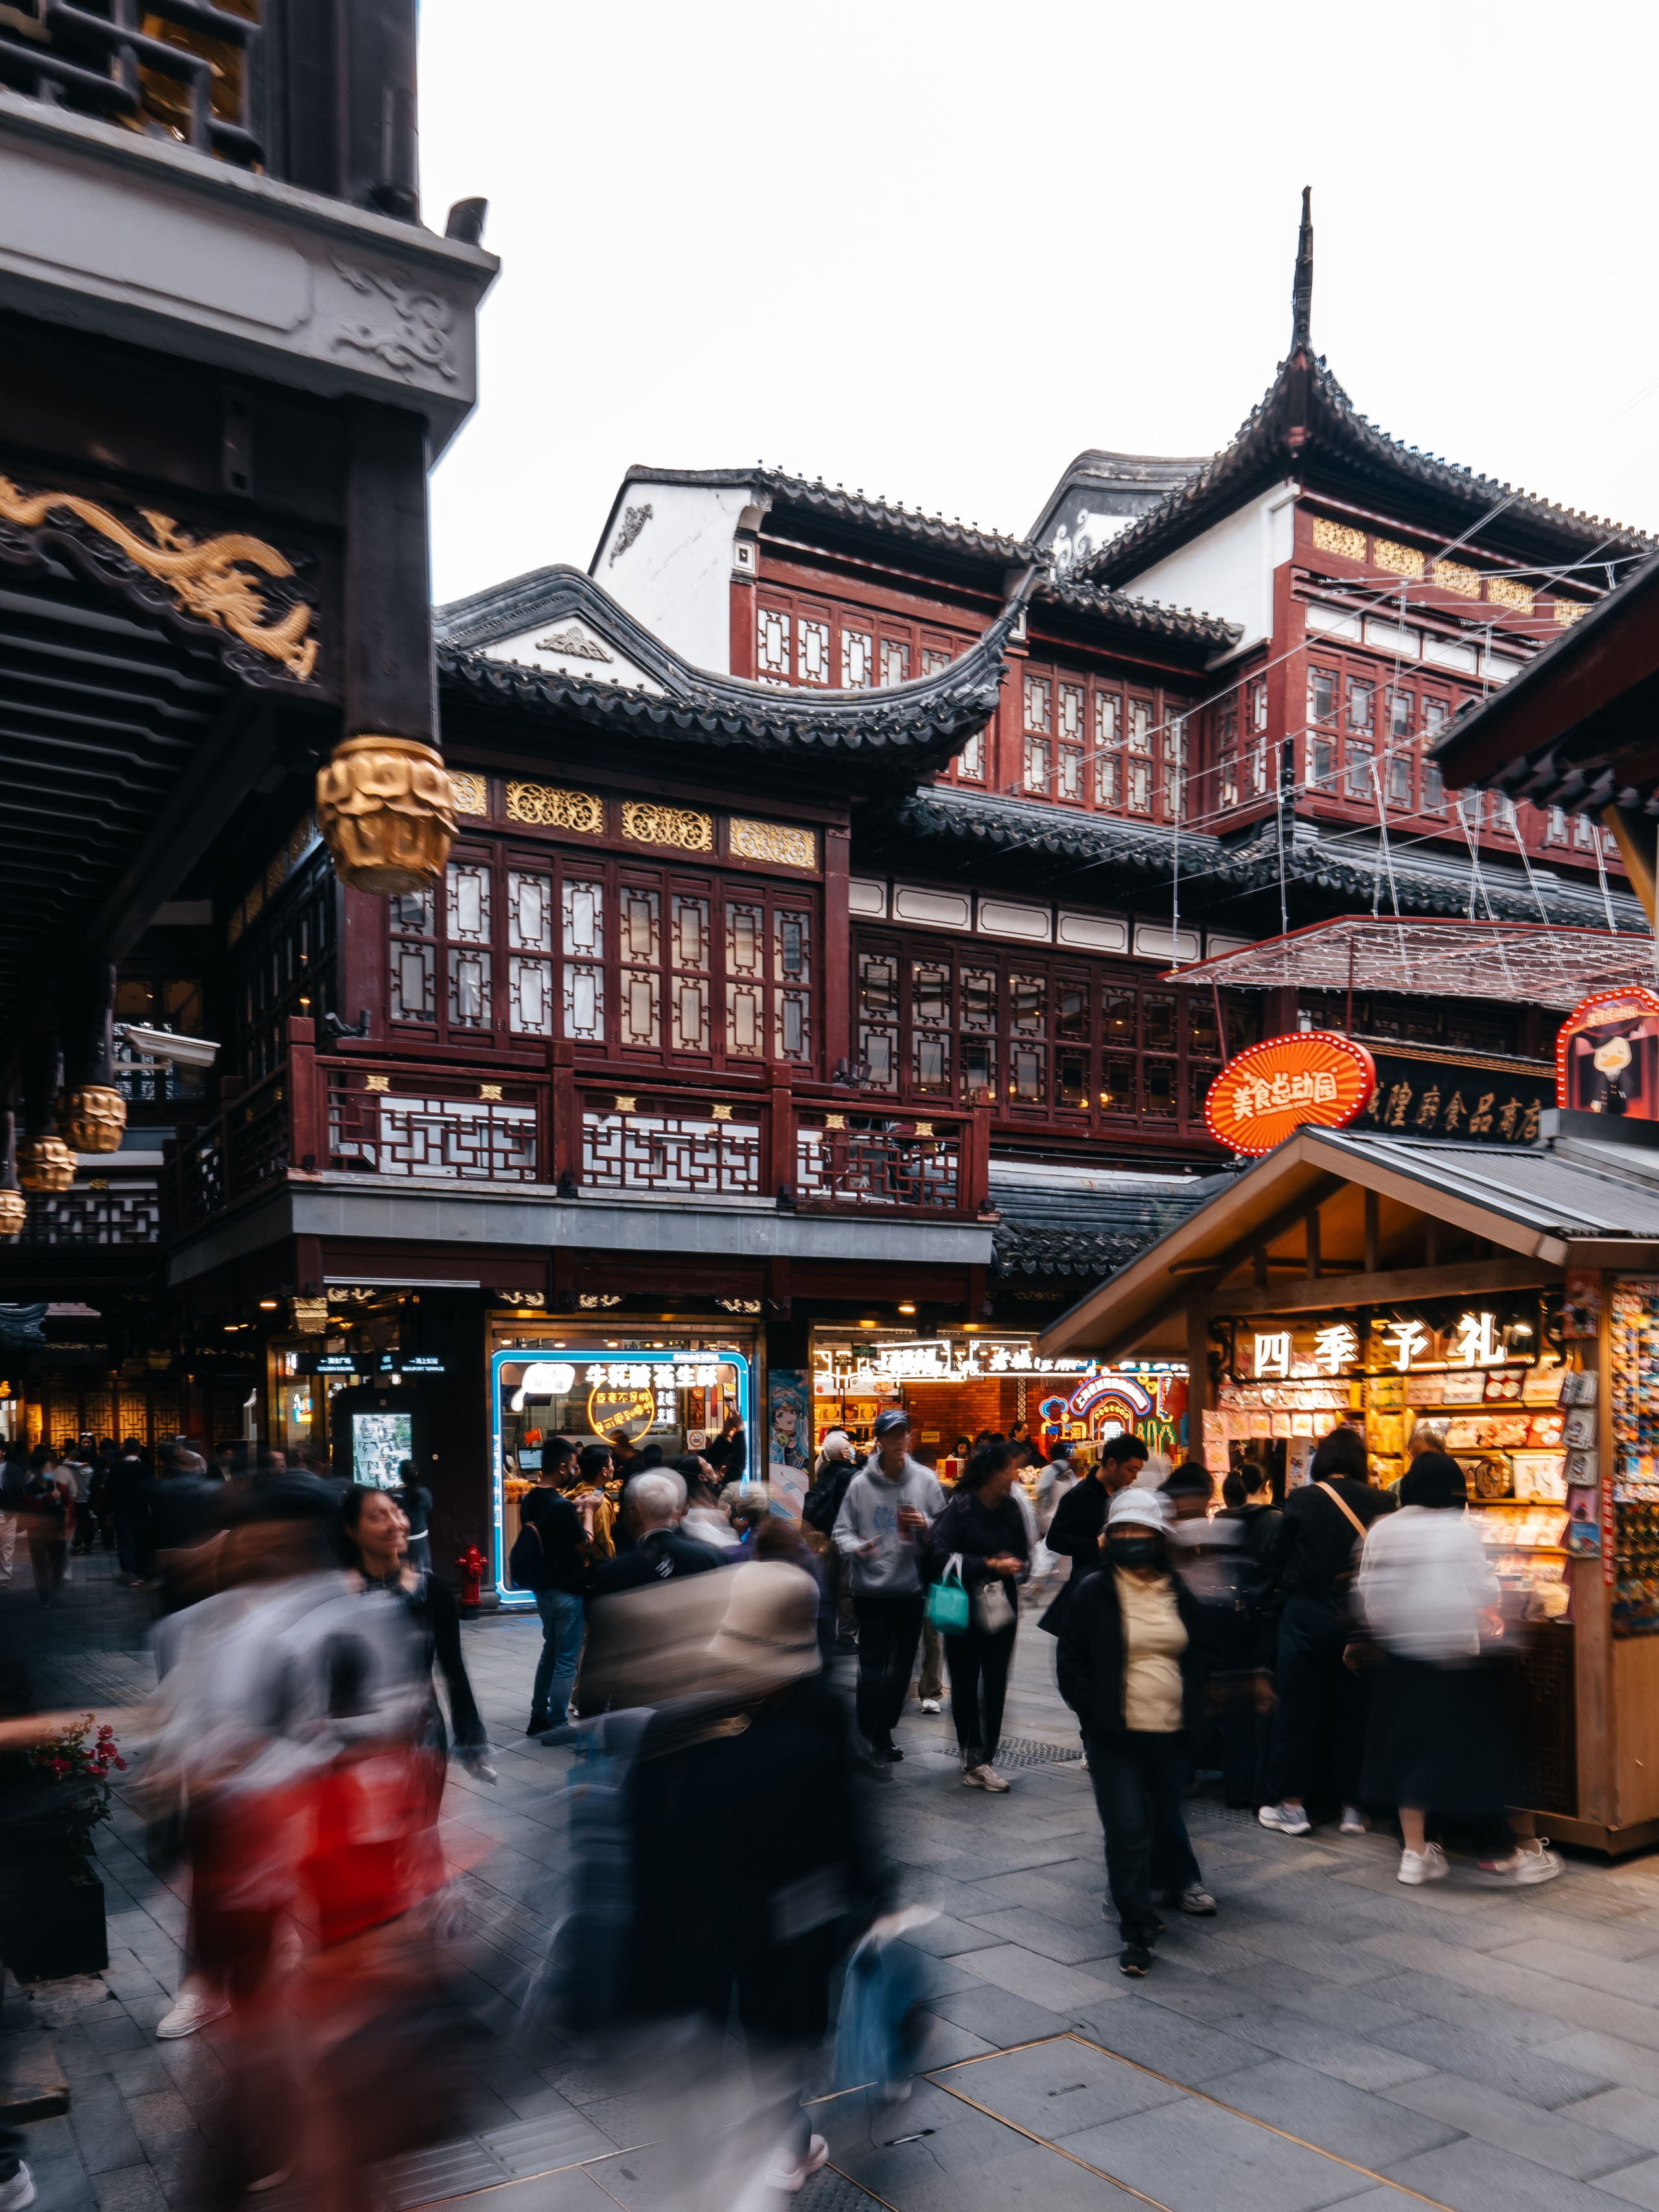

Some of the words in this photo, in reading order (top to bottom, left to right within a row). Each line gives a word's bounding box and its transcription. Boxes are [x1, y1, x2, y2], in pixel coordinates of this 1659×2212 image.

[1232, 1071, 1337, 1121] 美食总动园
[1254, 1312, 1508, 1379] 四季予礼
